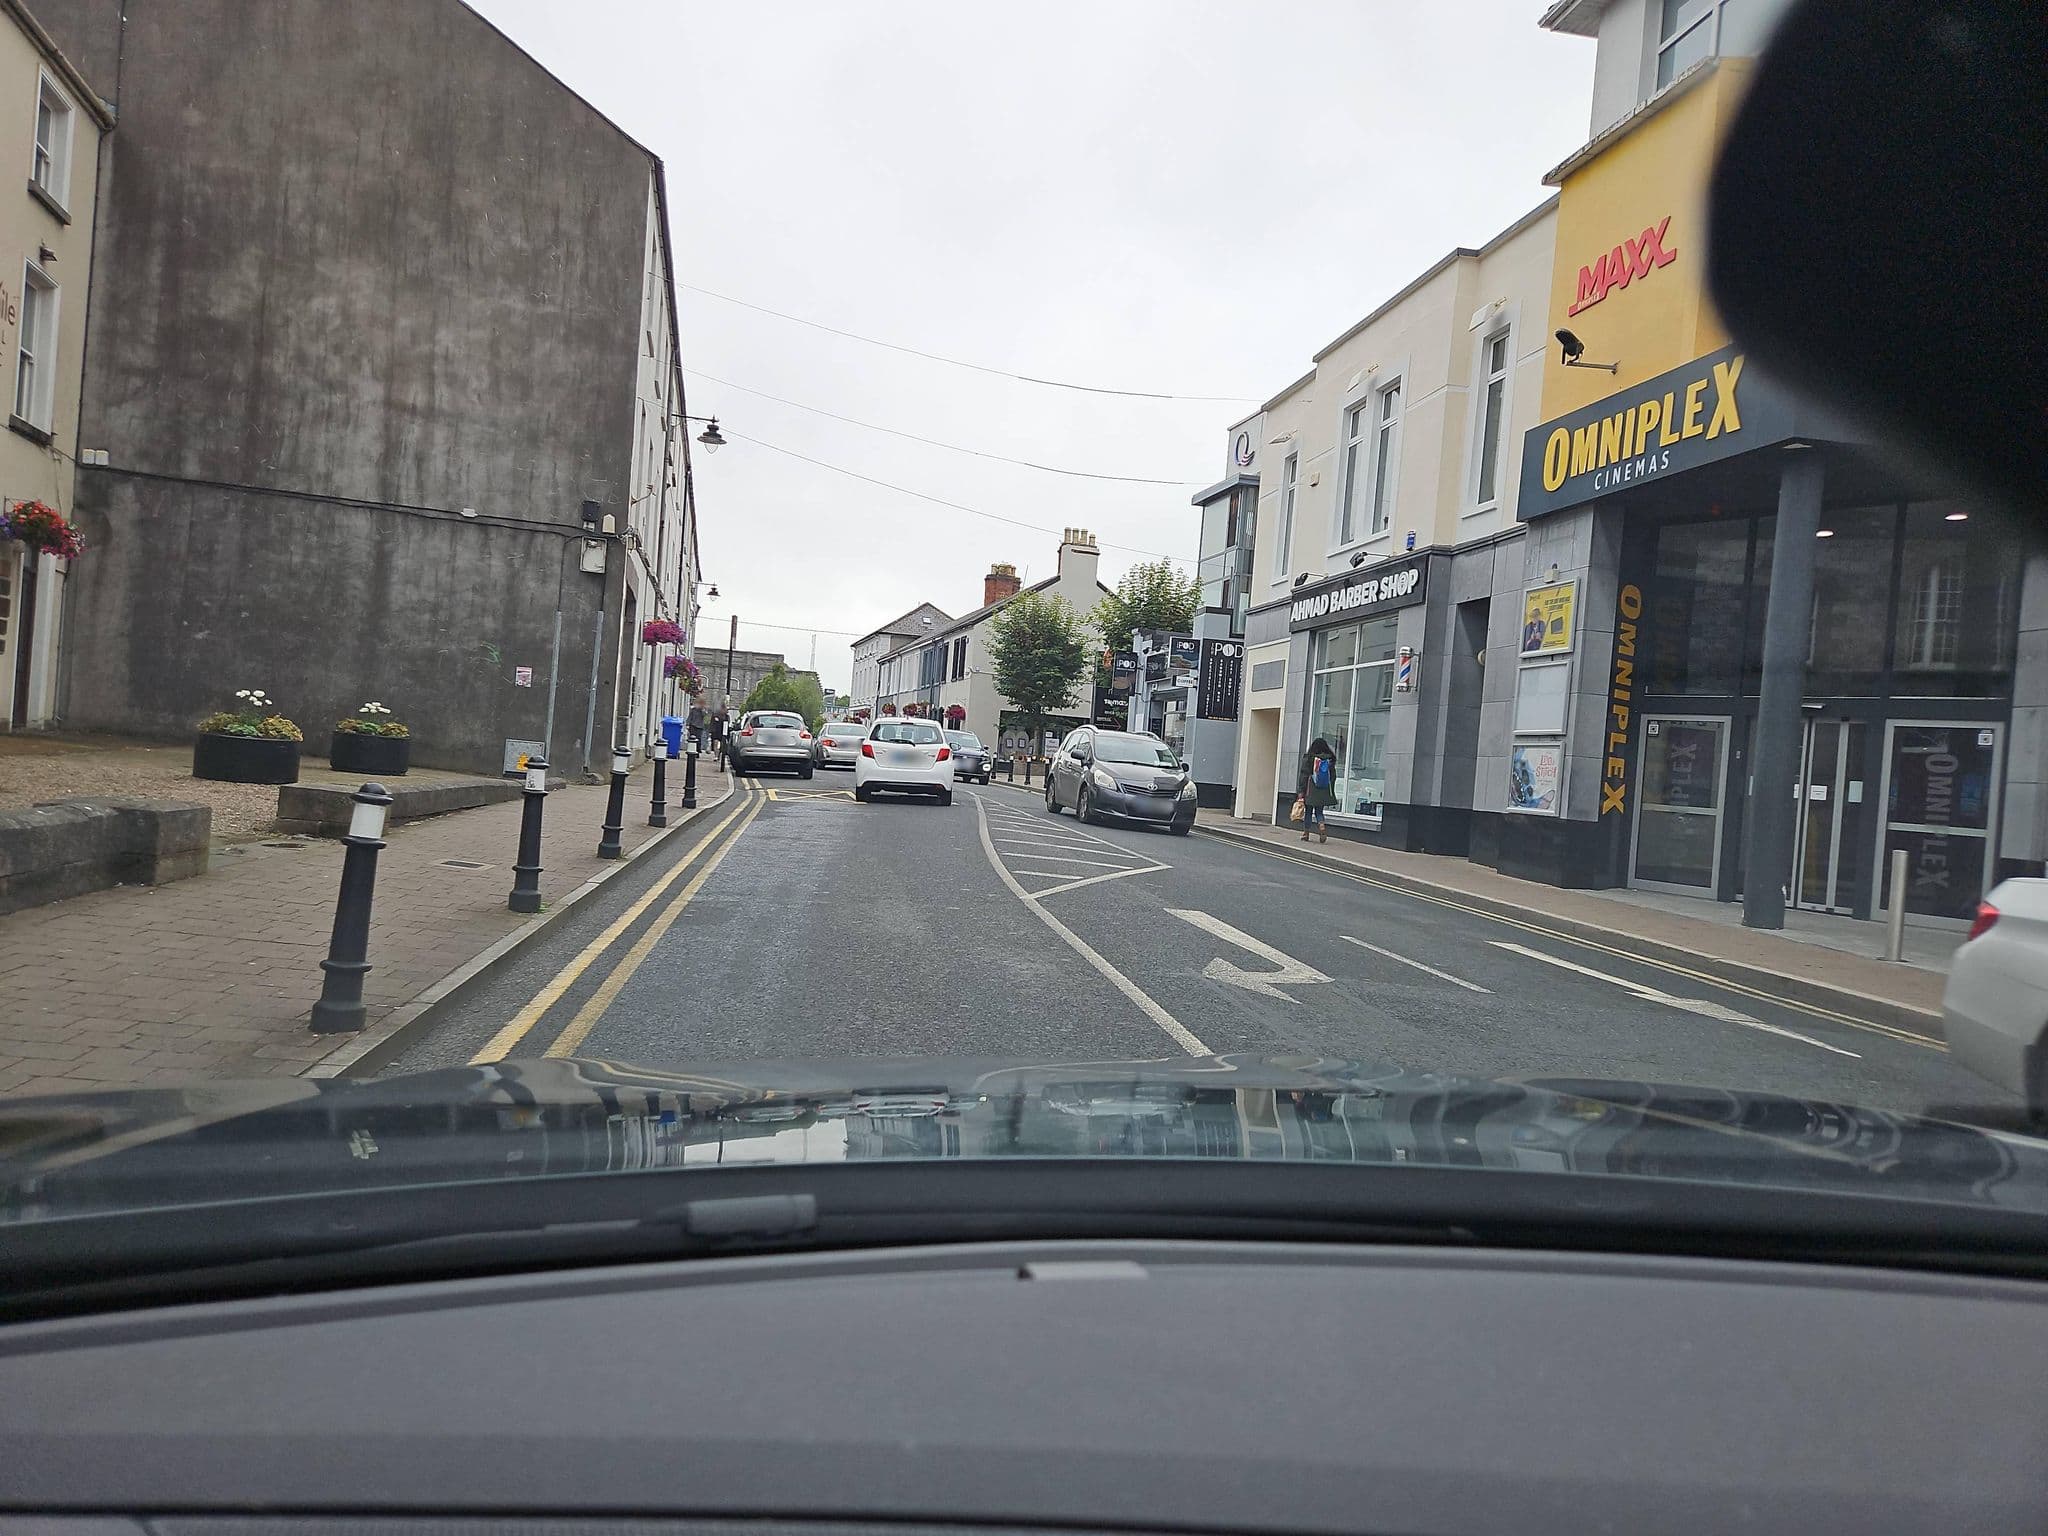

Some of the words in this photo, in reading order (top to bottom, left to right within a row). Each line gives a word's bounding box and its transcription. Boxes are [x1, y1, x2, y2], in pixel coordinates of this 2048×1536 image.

[1569, 215, 1677, 315] MAXX
[1543, 355, 1745, 492] OMNIPLEX
[1594, 450, 1670, 491] CINEMAS
[1290, 594, 1329, 622] AHMAD
[1330, 580, 1379, 613] BARBER
[1379, 568, 1419, 600] SHOP
[1602, 584, 1642, 815] OMNIPLEX
